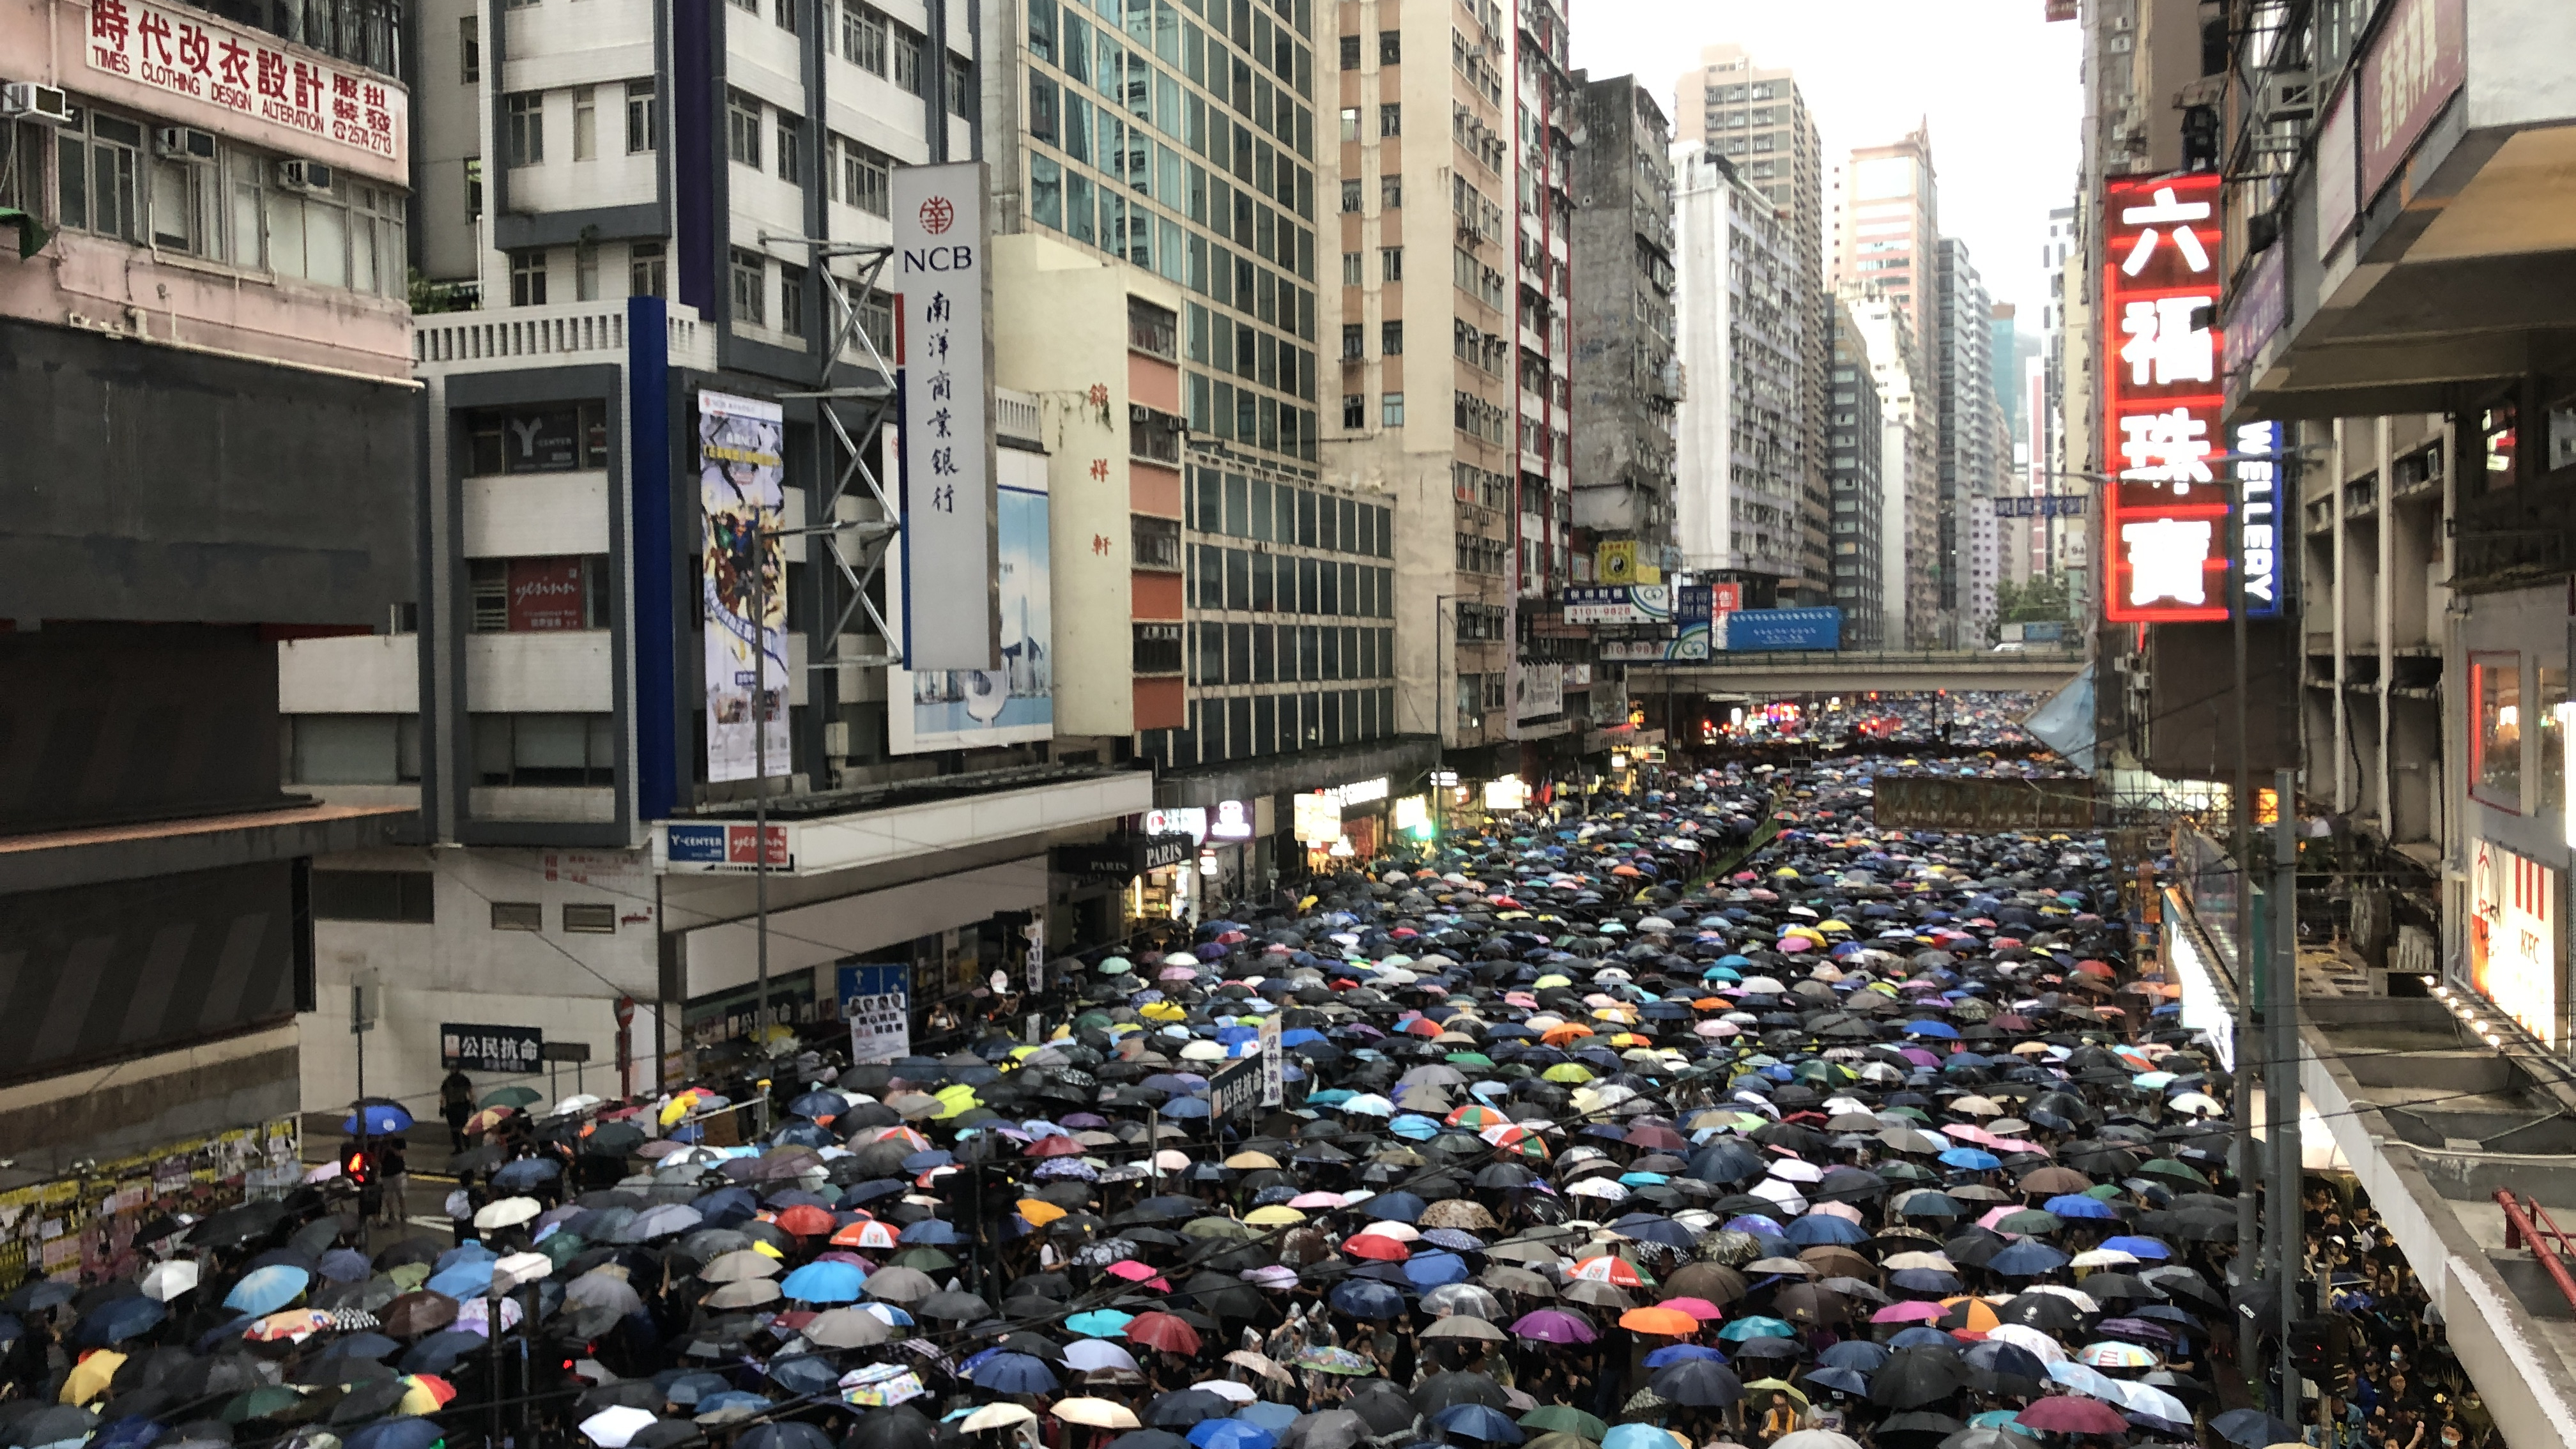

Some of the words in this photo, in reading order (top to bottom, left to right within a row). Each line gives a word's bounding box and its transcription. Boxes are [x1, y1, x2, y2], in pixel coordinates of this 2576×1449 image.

[92, 0, 324, 113] 時代改衣設計
[93, 45, 130, 75] TIMES
[141, 61, 201, 96] CLOTHING
[211, 82, 252, 111] DESIGN
[262, 99, 324, 134] ALTERATION
[348, 125, 369, 147] 2574
[371, 132, 392, 154] 2713
[904, 245, 972, 273] NCB
[926, 290, 960, 513] 南洋商業銀行
[671, 834, 722, 847] Y-CENTER
[1146, 842, 1183, 868] PARIS
[1091, 860, 1128, 871] PARIS
[2520, 928, 2540, 964] KFC
[462, 1035, 538, 1061] 公民抗命
[1222, 1066, 1262, 1113] 公民抗命
